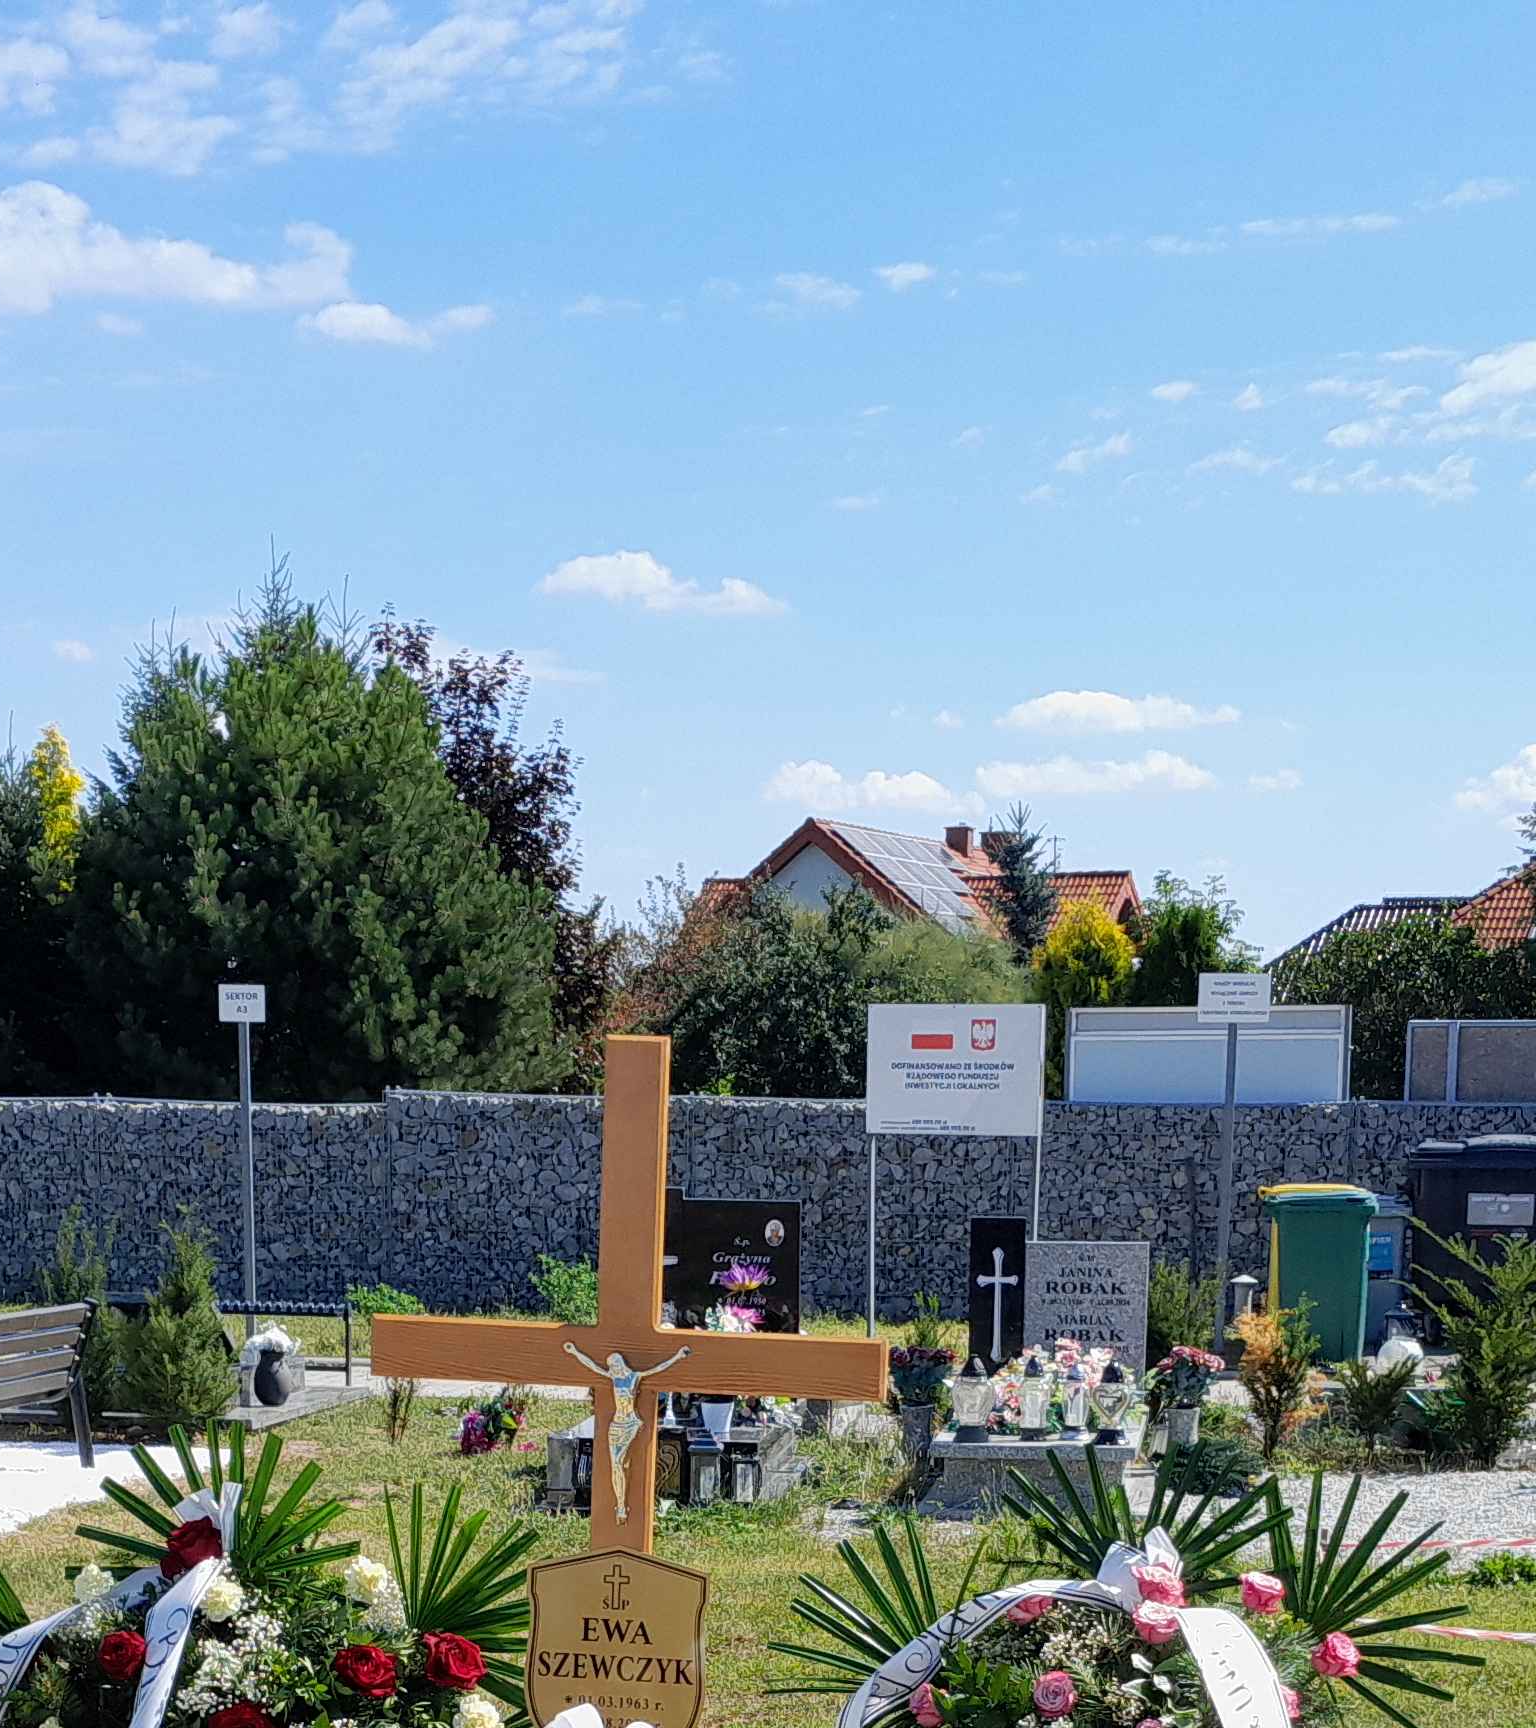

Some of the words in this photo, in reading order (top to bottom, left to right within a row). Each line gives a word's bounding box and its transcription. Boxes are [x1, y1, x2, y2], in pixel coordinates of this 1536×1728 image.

[224, 992, 258, 1001] SEKTOR
[236, 1005, 248, 1014] A3
[891, 1062, 962, 1071] DOFINANSOWANO
[963, 1062, 972, 1071] ZE
[973, 1061, 1016, 1071] ŚRODKÓW
[906, 1073, 957, 1081] RZĄDOWEGO
[958, 1073, 1000, 1081] FUNDUSZU
[905, 1082, 951, 1091] INWESTYCJI
[952, 1082, 1001, 1091] LOKALNYCH
[712, 1251, 771, 1266] Grażyna
[1058, 1267, 1113, 1278] JANINA
[1045, 1281, 1127, 1295] ROBAK
[1056, 1314, 1113, 1326] MARIAN
[1044, 1328, 1125, 1342] ROBAK
[582, 1617, 653, 1645] EWA
[538, 1651, 694, 1686] SZEWCZYK
